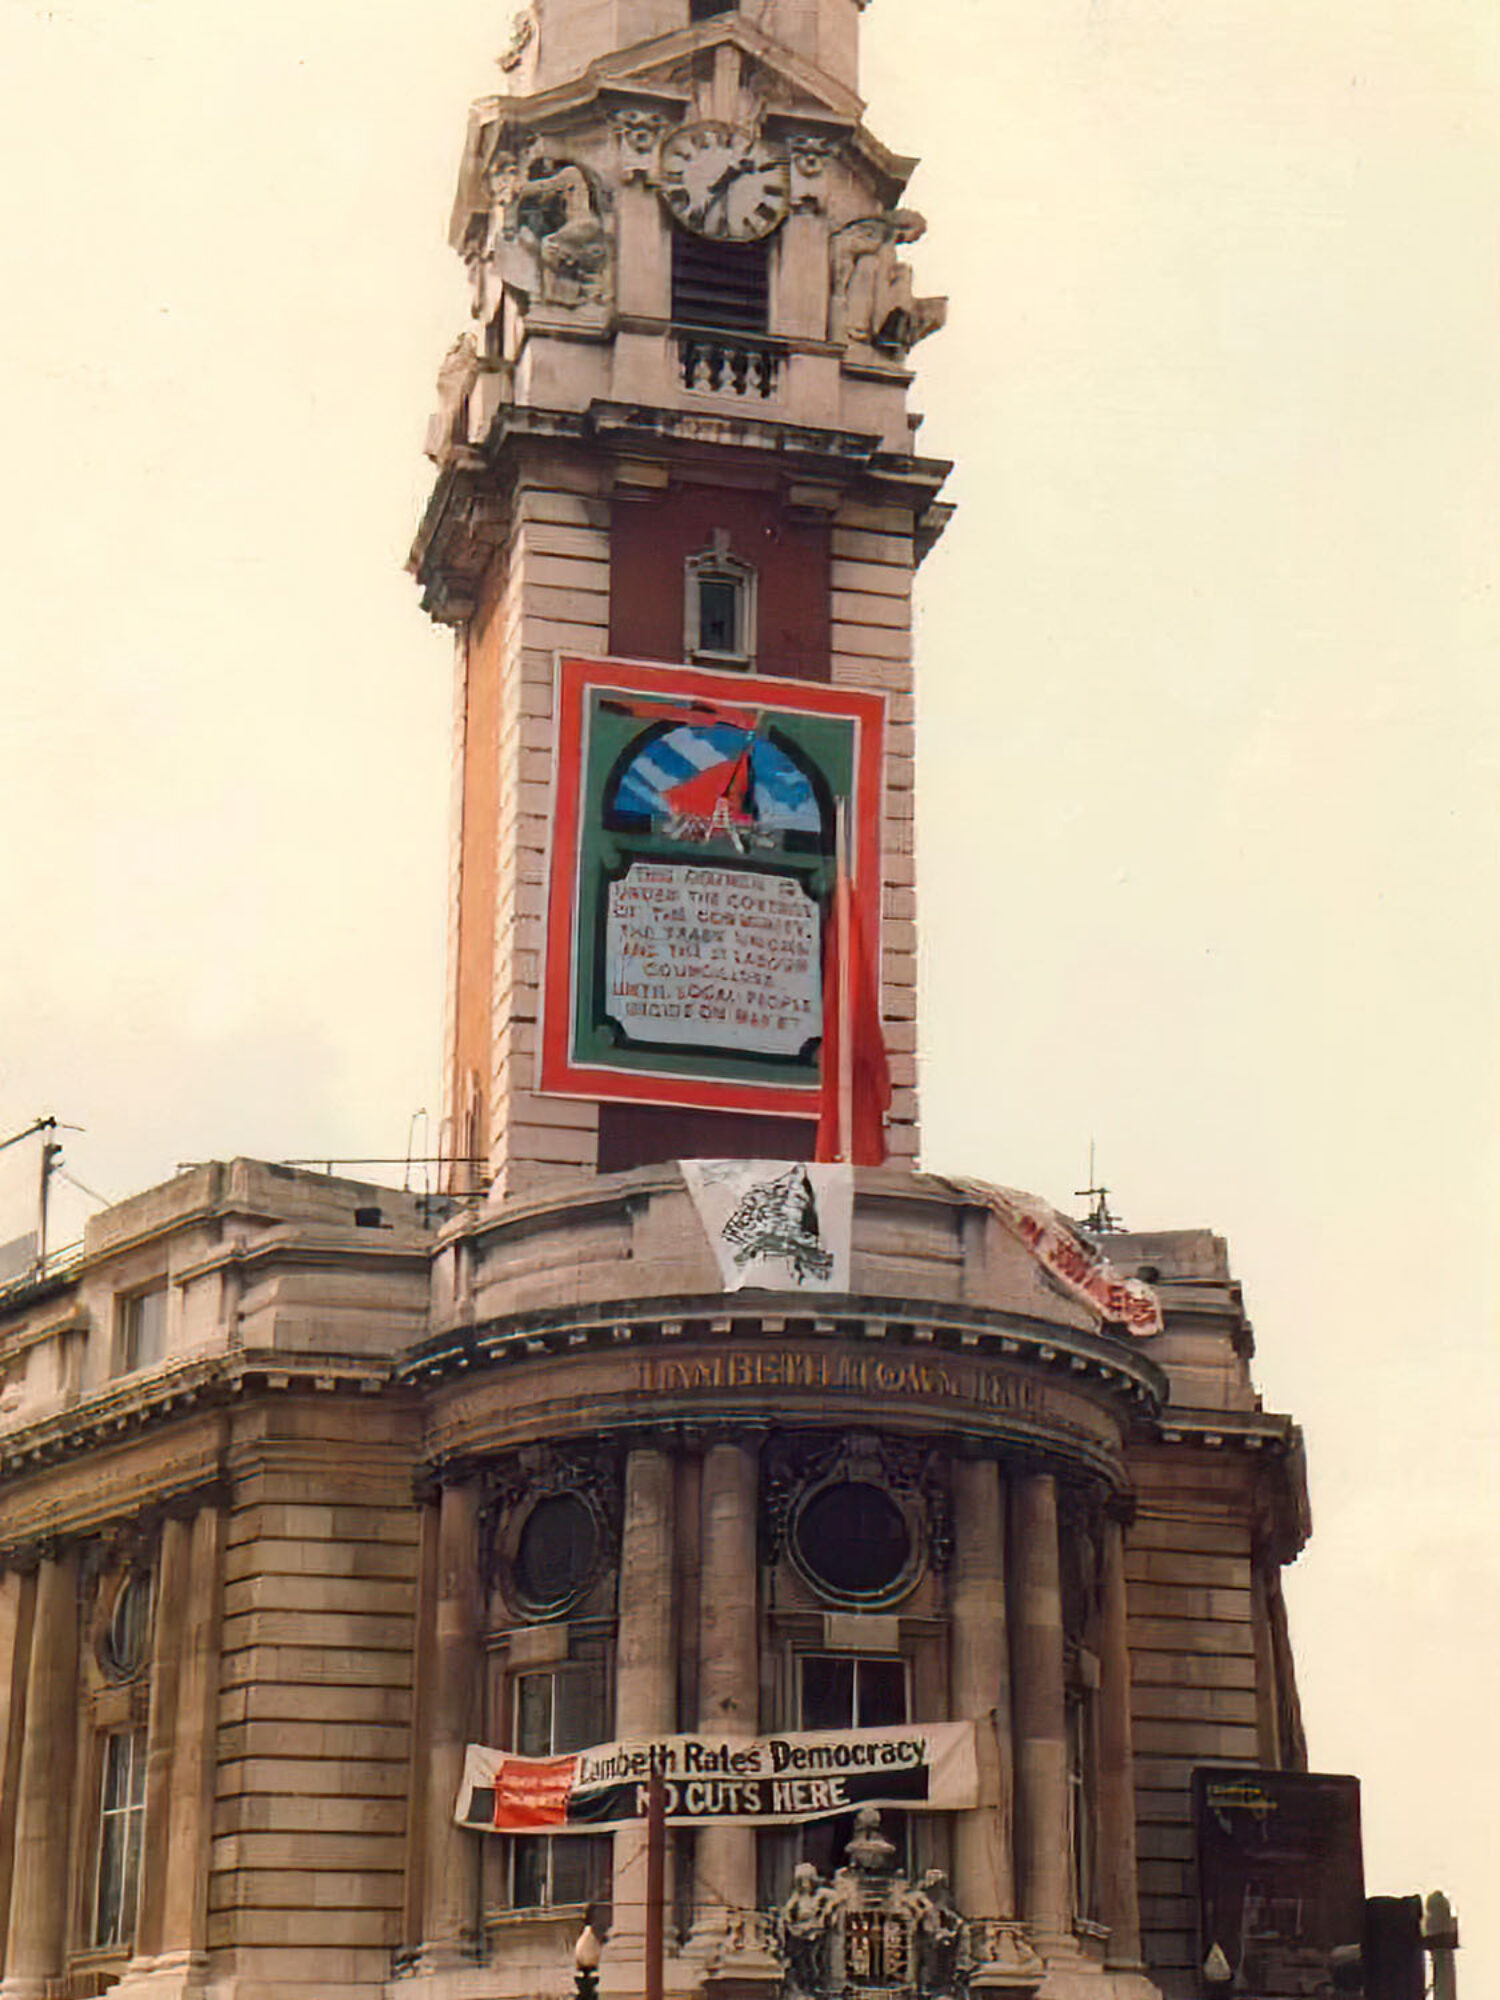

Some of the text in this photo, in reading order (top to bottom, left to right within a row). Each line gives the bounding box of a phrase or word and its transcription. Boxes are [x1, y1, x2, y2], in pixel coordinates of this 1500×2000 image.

[684, 1742, 762, 1774] Rates
[769, 1737, 928, 1771] Democracy
[685, 1781, 762, 1815] CUTS
[773, 1777, 852, 1813] HERE
